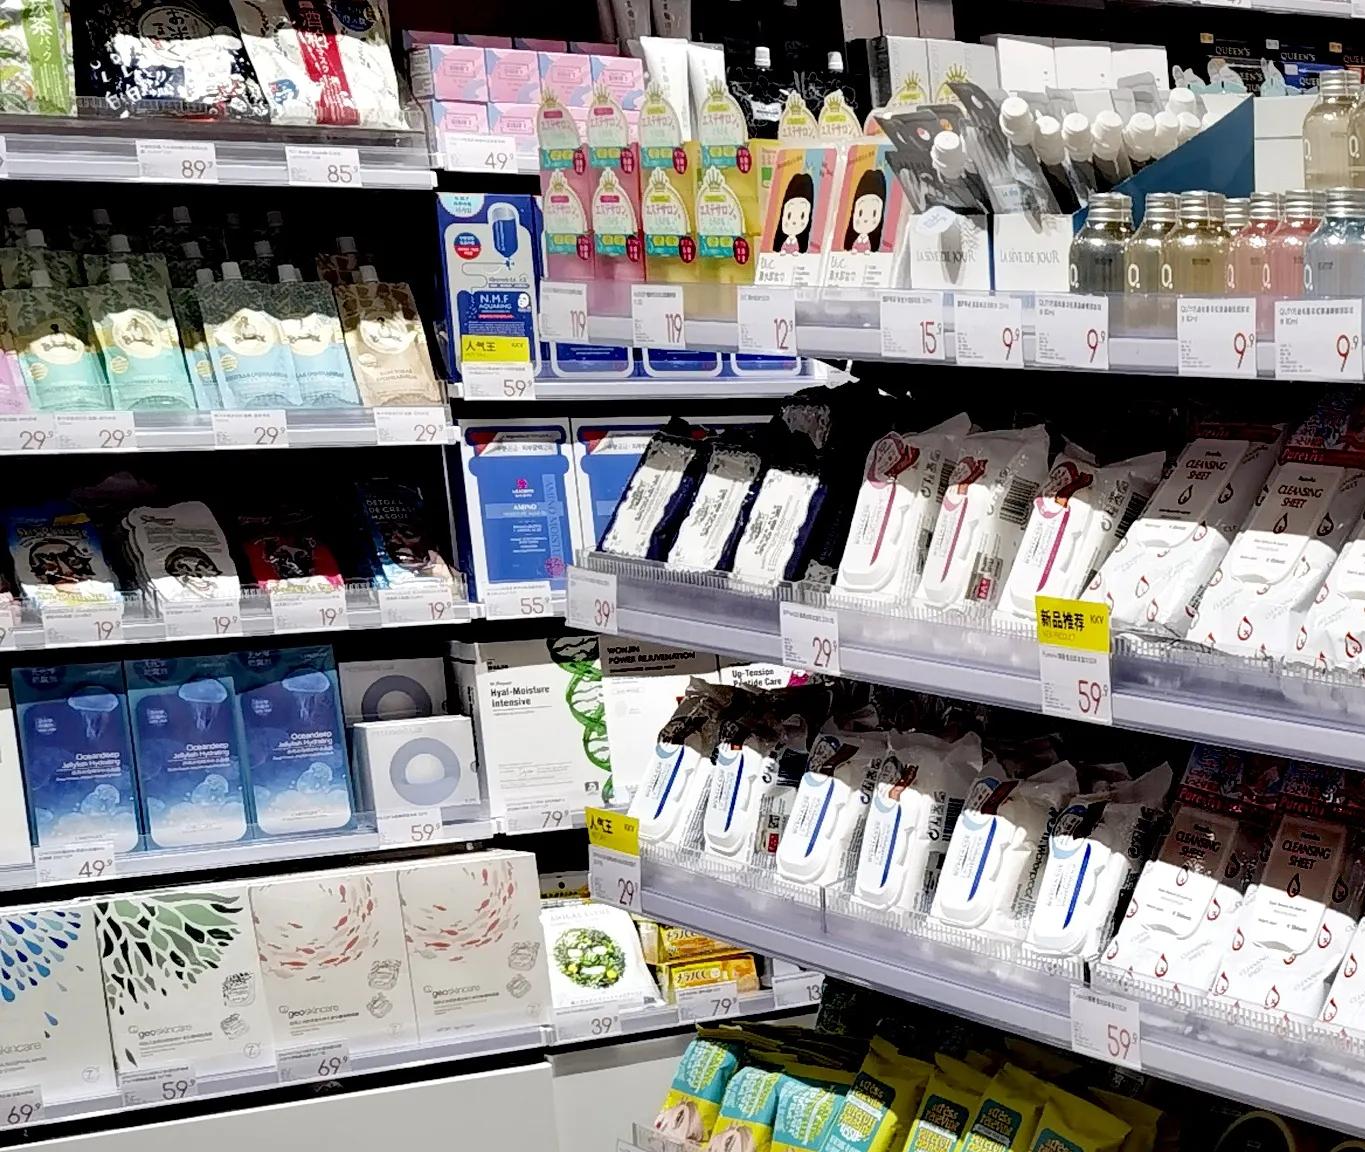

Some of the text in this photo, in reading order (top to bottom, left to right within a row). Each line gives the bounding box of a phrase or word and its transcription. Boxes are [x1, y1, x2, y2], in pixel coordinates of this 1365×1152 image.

[571, 311, 585, 336] 119
[666, 314, 682, 343] 119
[1041, 606, 1085, 631] 新品推荐
